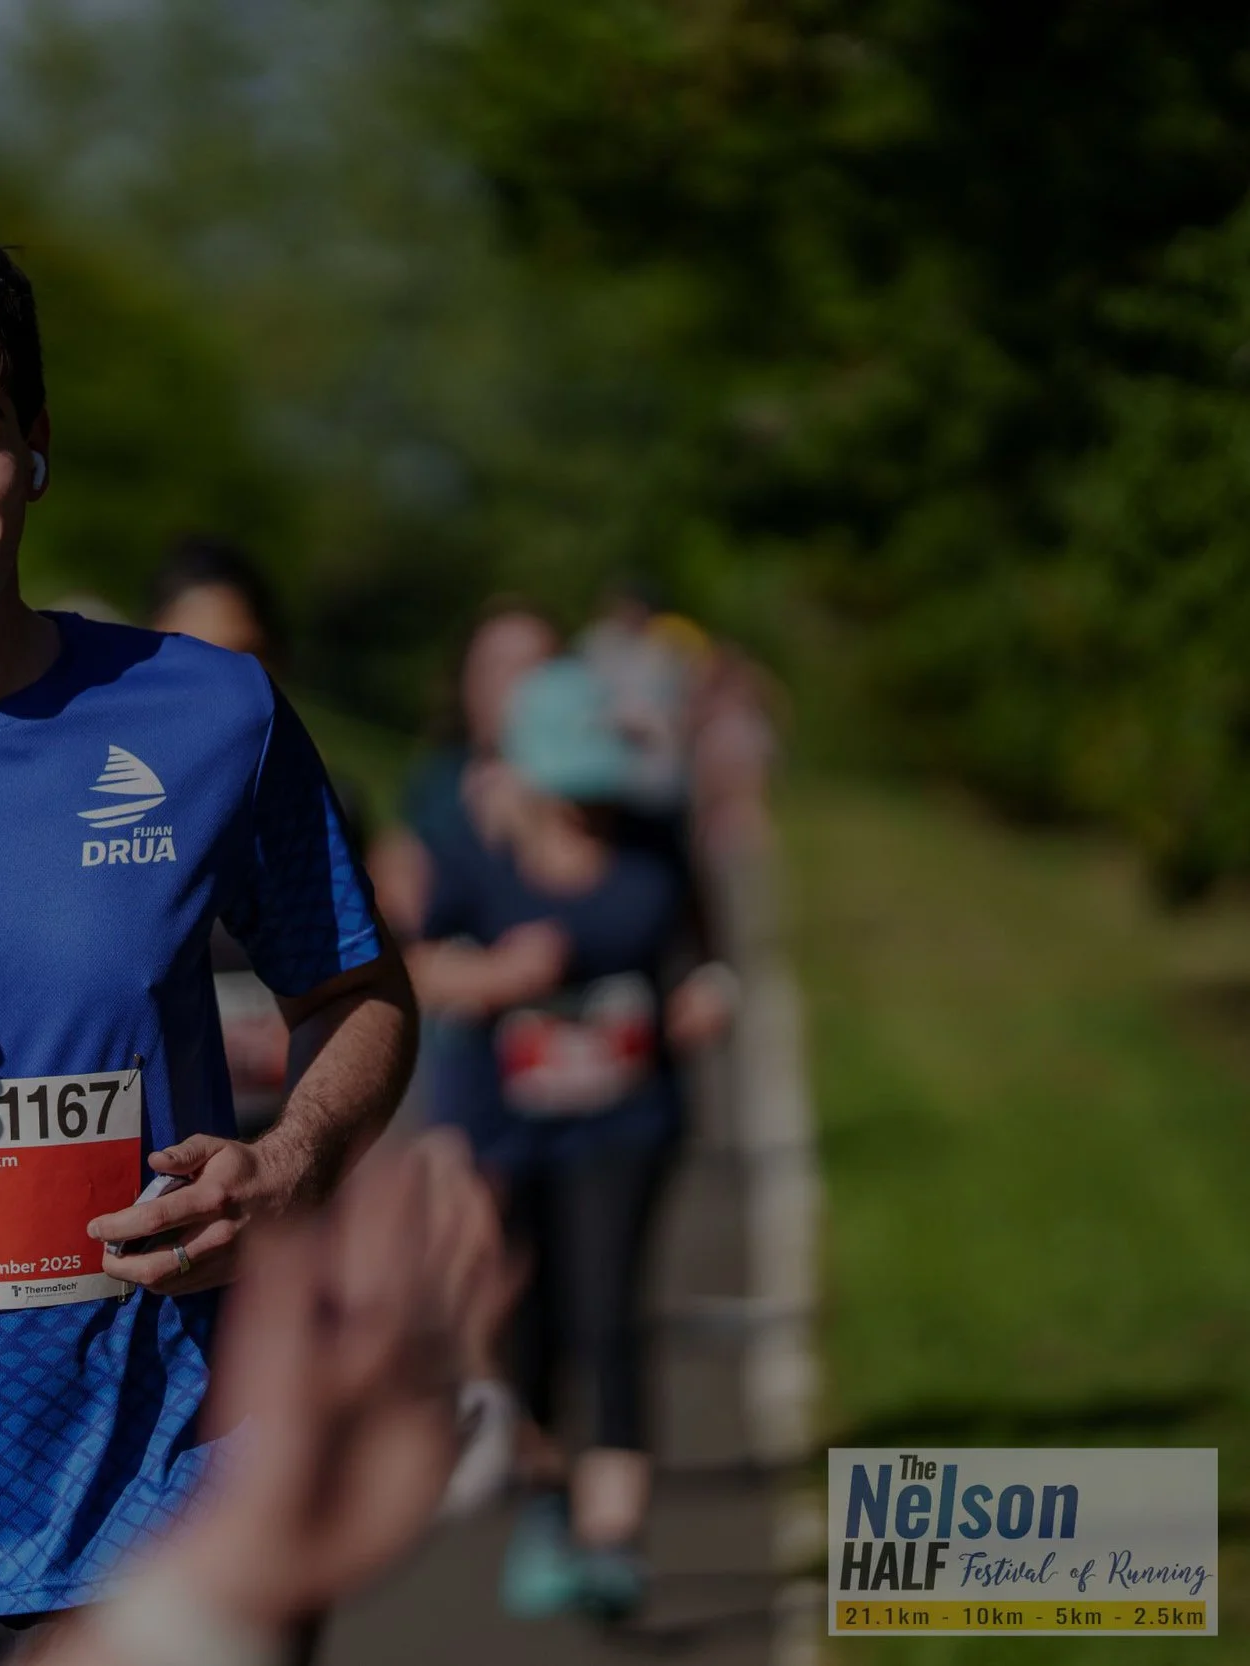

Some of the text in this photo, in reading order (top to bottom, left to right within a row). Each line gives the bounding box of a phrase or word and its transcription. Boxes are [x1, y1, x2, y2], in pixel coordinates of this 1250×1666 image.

[133, 826, 172, 837] FIJIAN
[82, 837, 177, 867] DRUA
[40, 1254, 81, 1272] 2025
